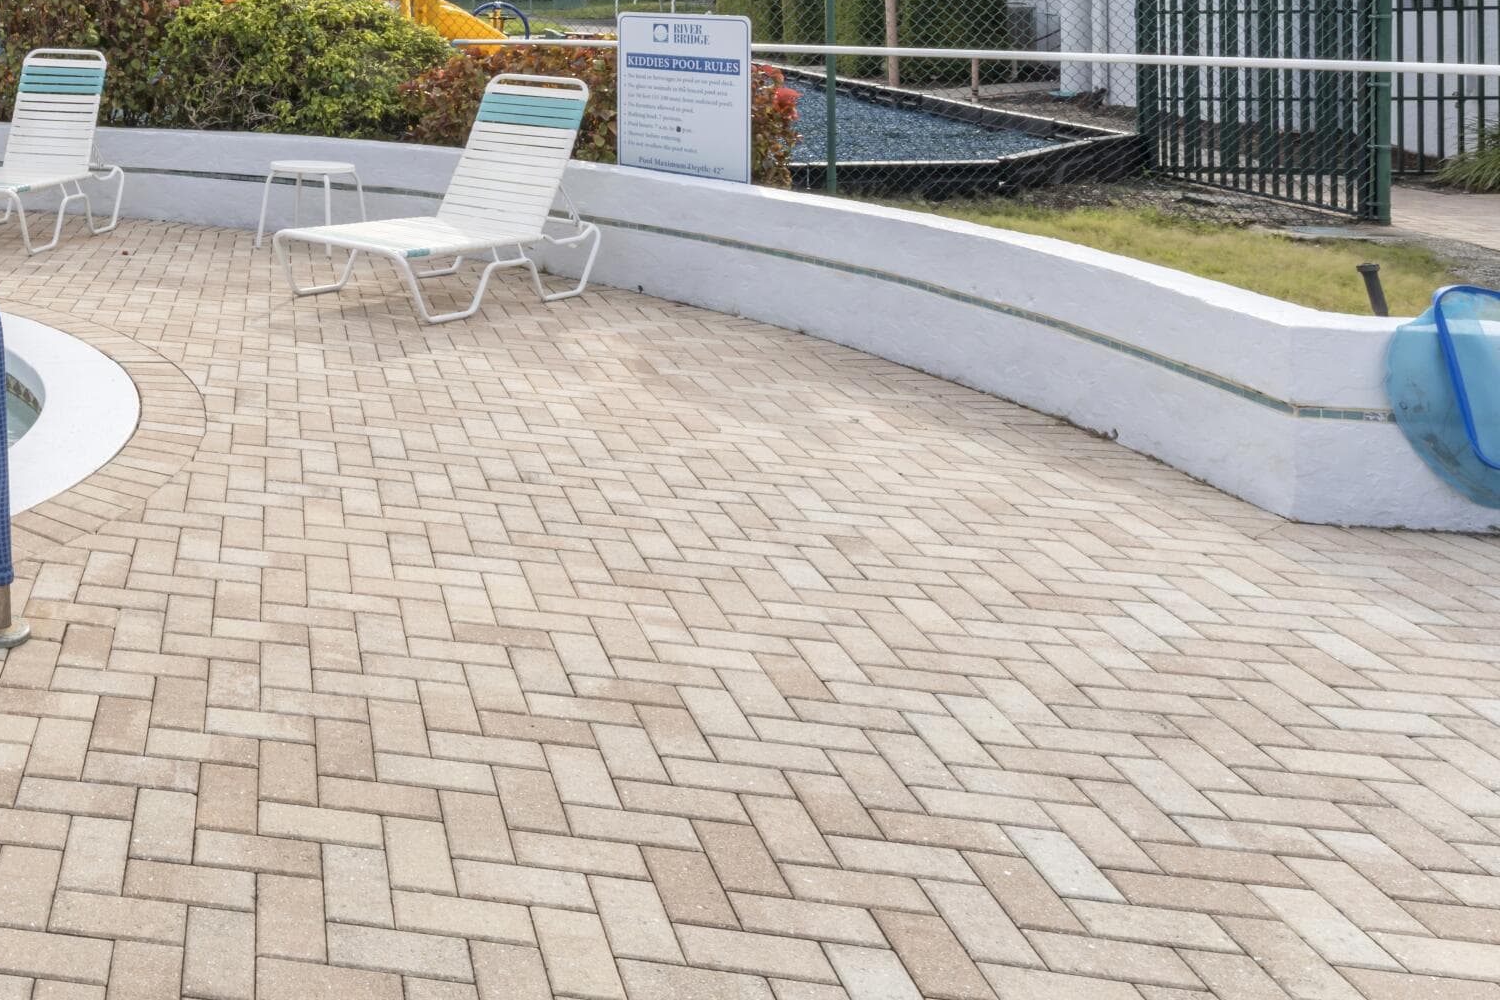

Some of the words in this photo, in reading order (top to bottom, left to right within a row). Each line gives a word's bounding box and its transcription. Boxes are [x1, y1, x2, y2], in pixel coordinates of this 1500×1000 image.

[673, 23, 702, 34] RIVER
[673, 34, 710, 45] BRIDGE
[627, 55, 670, 68] KIDDIES
[672, 59, 702, 71] POOL
[704, 61, 739, 73] RULES
